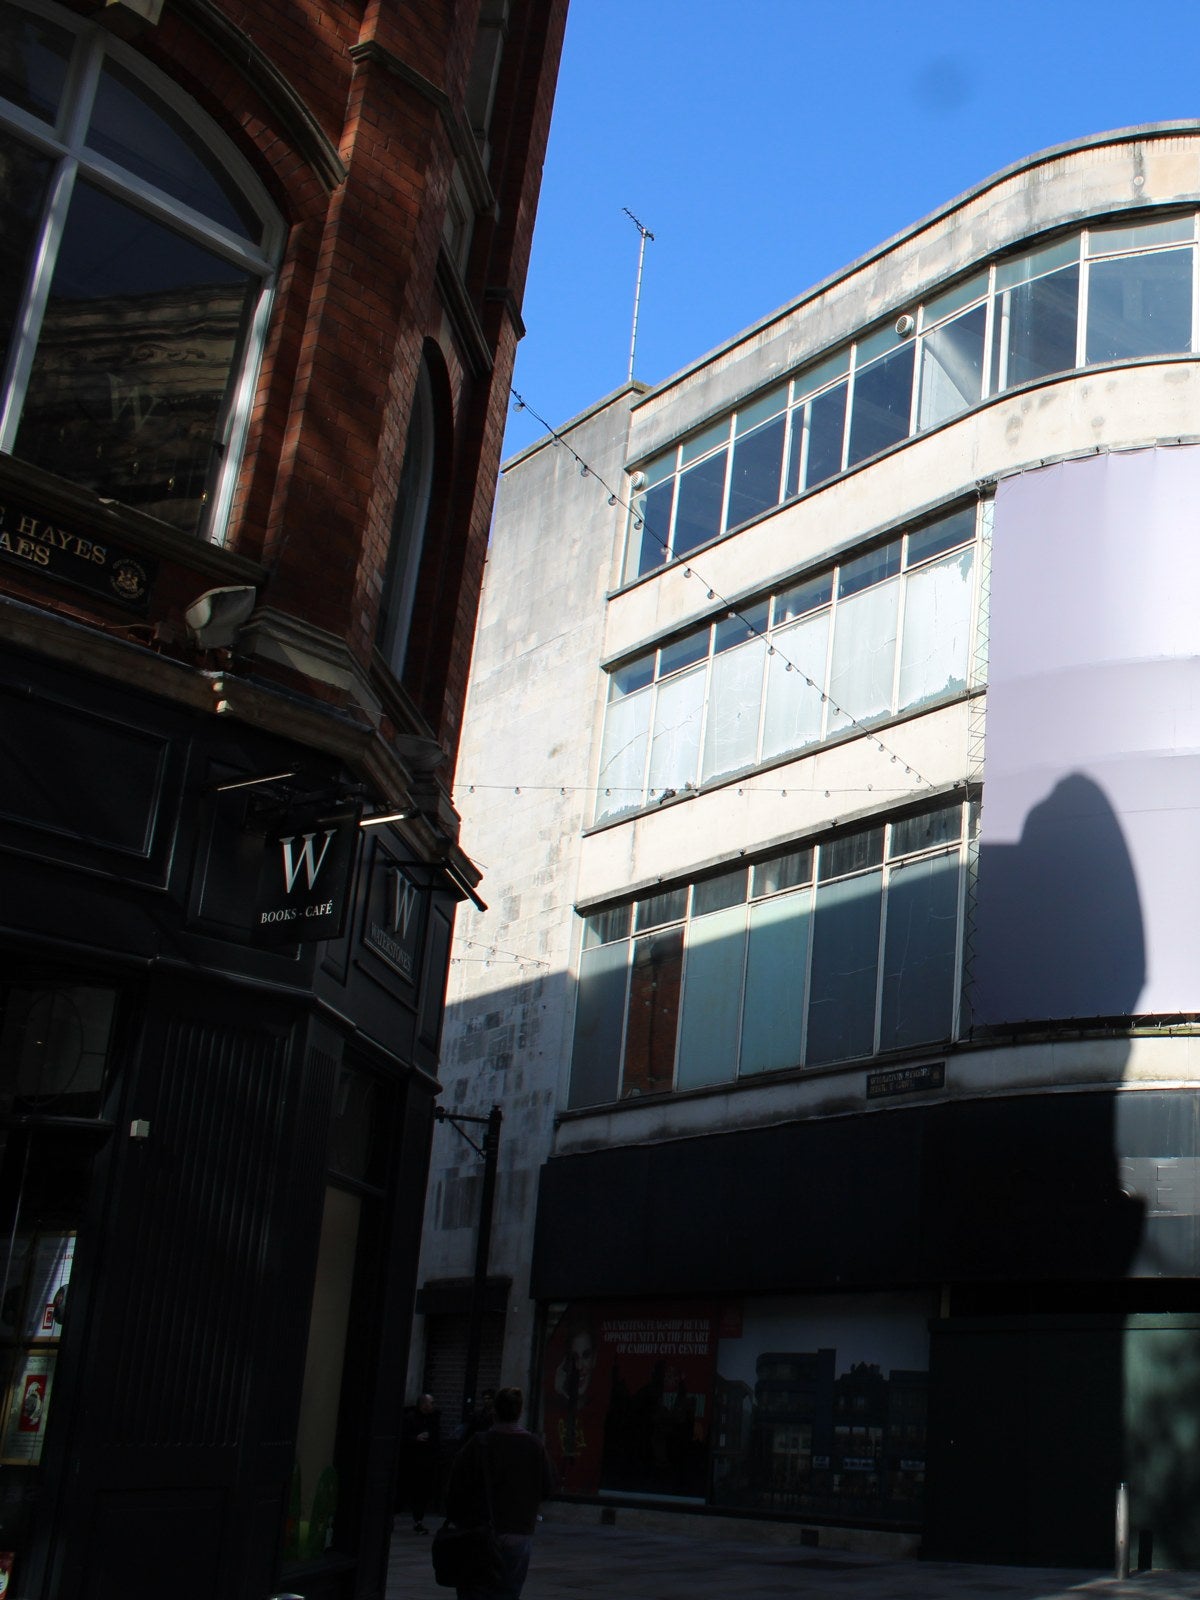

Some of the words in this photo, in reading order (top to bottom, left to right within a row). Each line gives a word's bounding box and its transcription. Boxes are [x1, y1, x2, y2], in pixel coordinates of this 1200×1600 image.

[0, 530, 50, 566] AES
[17, 514, 108, 565] HAYES
[279, 829, 338, 894] W
[261, 908, 297, 924] BOOKS
[305, 900, 333, 917] CAFÉ
[392, 867, 419, 940] W
[604, 1331, 656, 1343] OPPORTUNITY
[666, 1331, 683, 1343] THE
[683, 1331, 710, 1343] HEART
[659, 1343, 677, 1355] CITY
[678, 1343, 709, 1355] CENTRE
